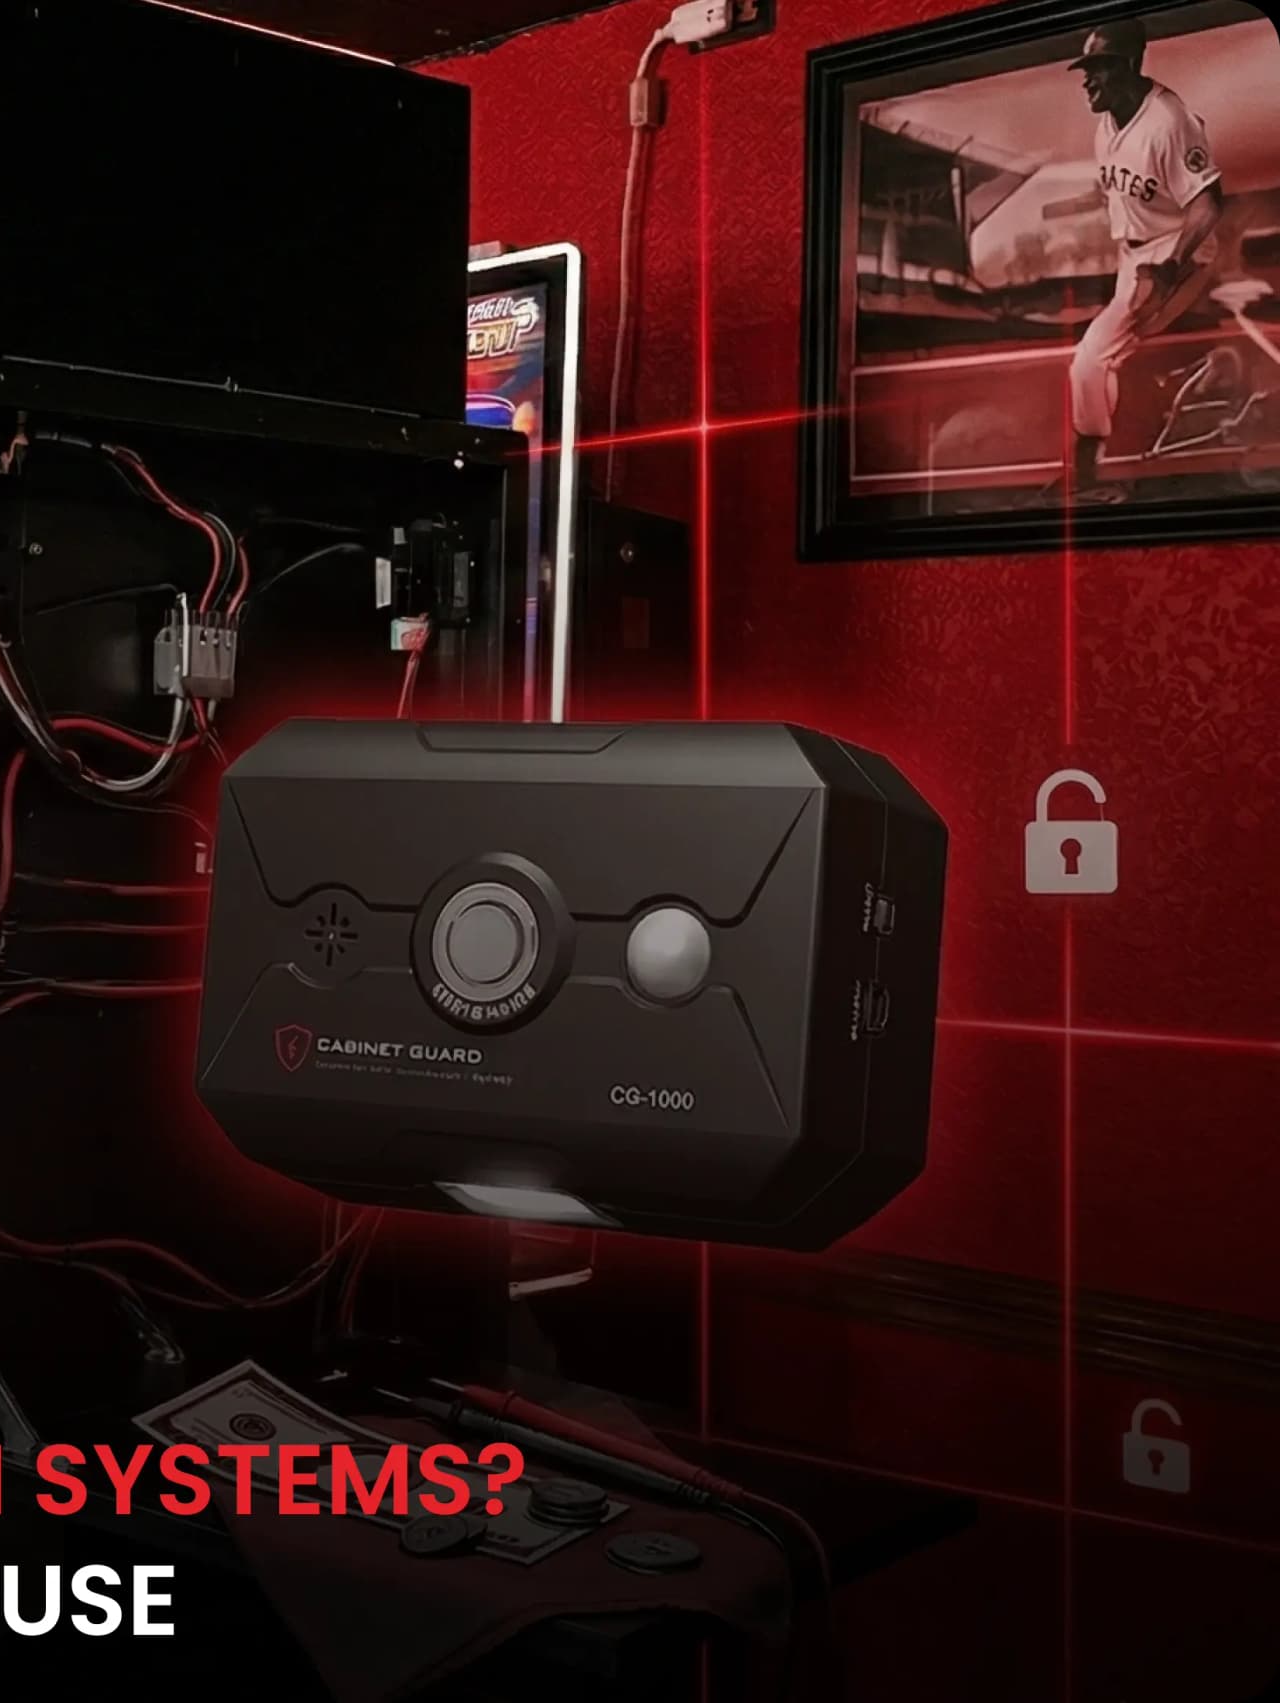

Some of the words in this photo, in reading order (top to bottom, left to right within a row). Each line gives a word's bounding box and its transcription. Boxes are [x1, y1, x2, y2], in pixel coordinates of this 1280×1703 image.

[316, 1037, 405, 1058] CABINET
[409, 1044, 483, 1065] GUARD
[610, 1085, 695, 1111] CG-1000
